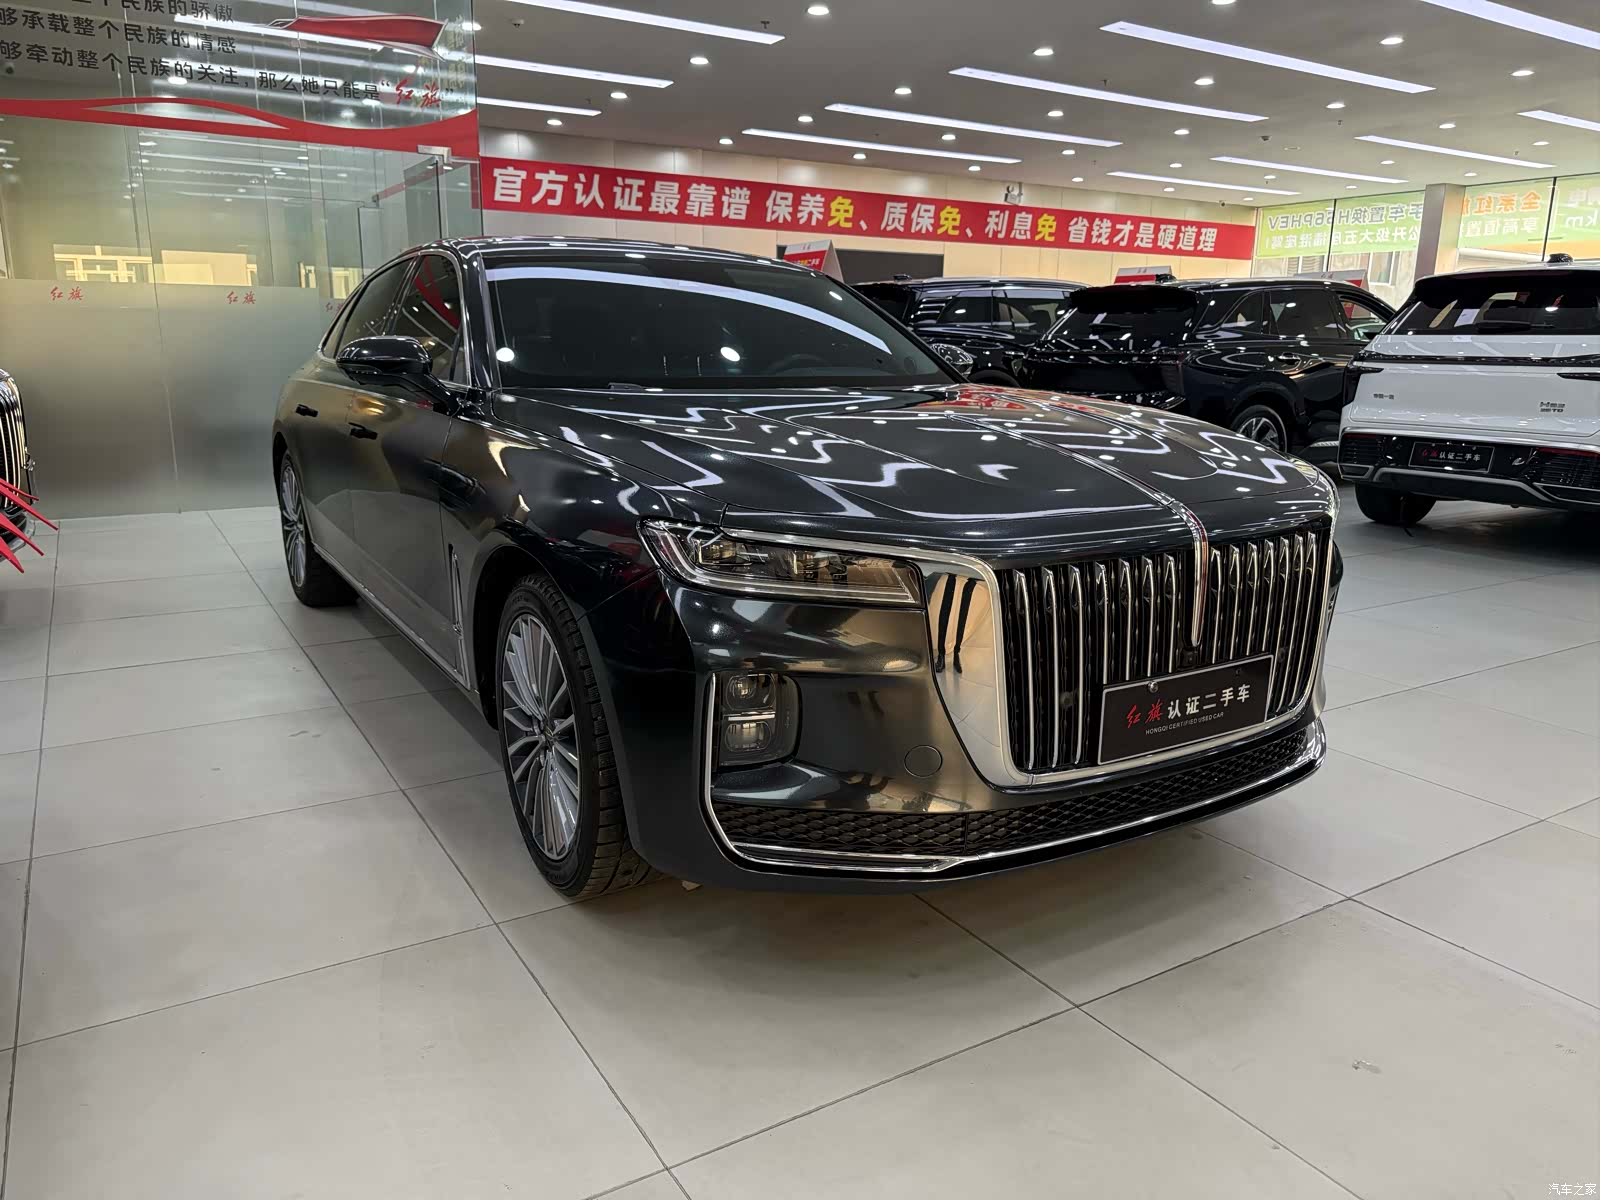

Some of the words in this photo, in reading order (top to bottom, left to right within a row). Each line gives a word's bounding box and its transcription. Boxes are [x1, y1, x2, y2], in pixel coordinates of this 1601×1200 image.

[72, 0, 234, 23] 民族的骄傲
[493, 167, 751, 221] 官方认证最靠谱
[1068, 217, 1219, 252] 省钱才是硬道理
[50, 286, 84, 301] 红旗
[226, 291, 256, 305] 红旗
[1145, 725, 1168, 735] HONGQI
[1168, 718, 1197, 730] CERTIFIED
[1213, 711, 1224, 719] CAR
